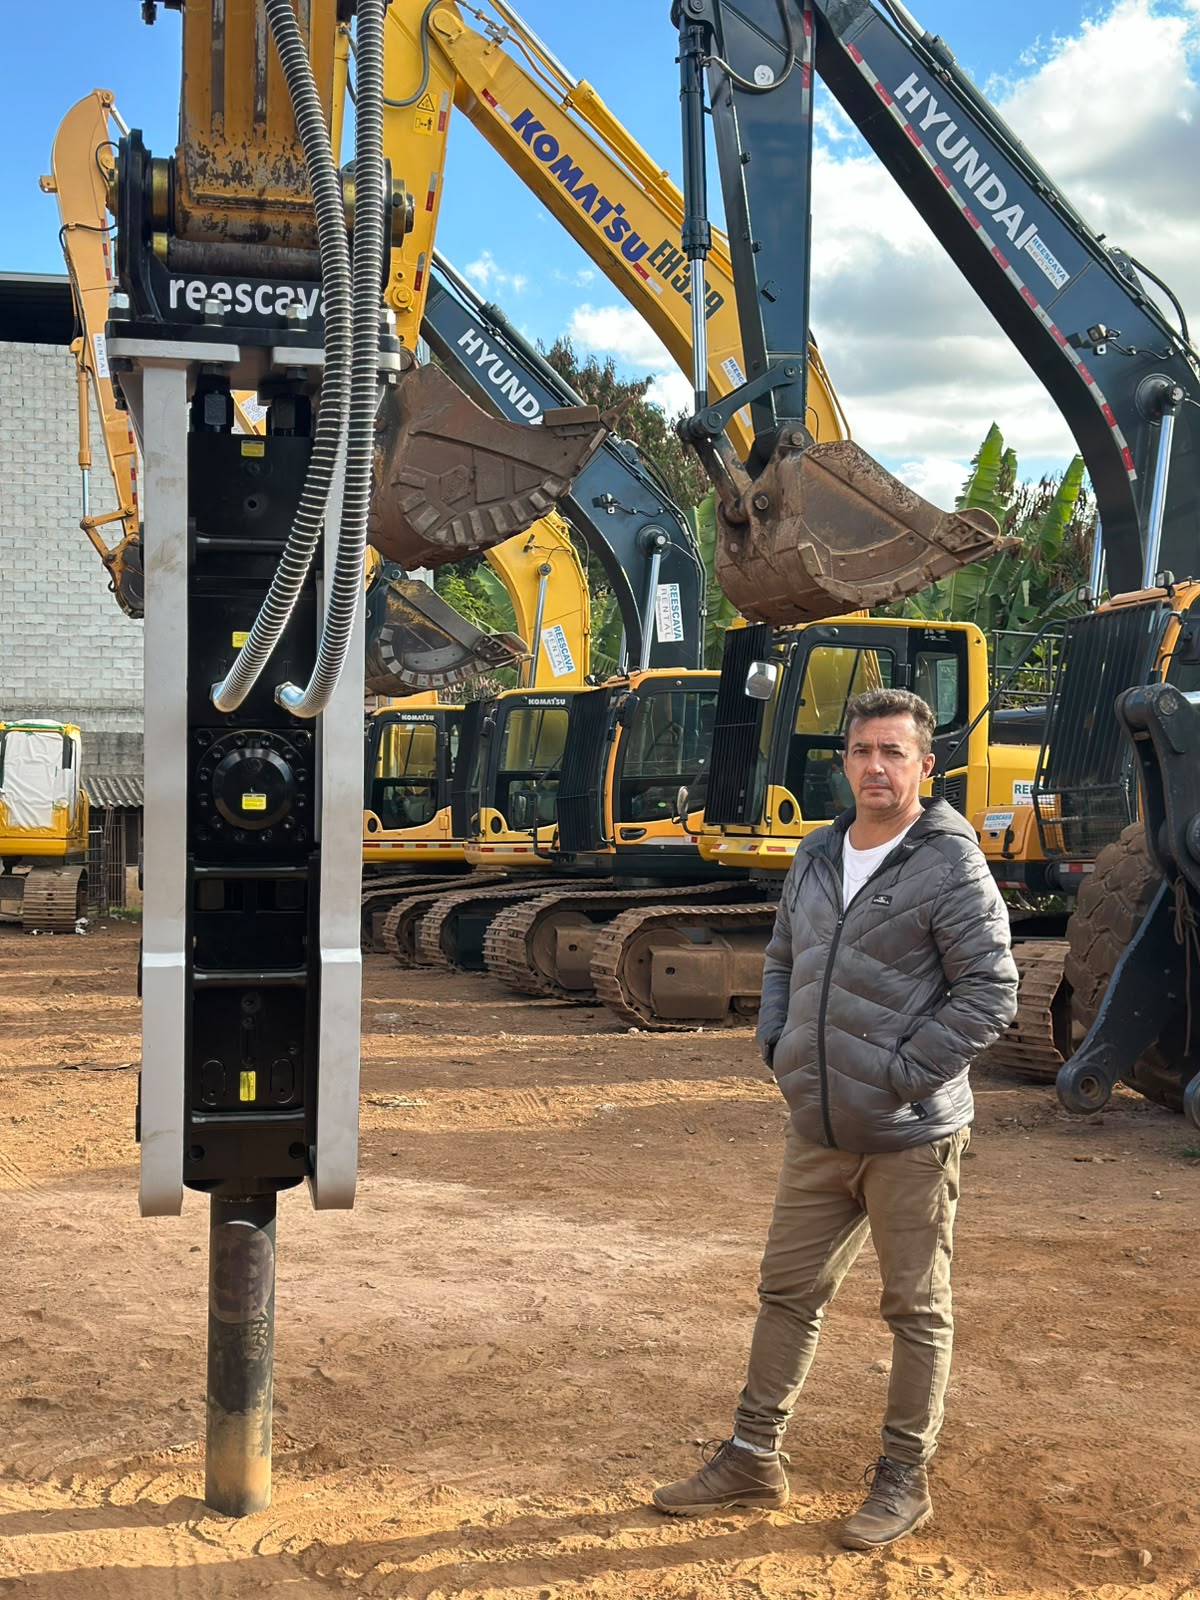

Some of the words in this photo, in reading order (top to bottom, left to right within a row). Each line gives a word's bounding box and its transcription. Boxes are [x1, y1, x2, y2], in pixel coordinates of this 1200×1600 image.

[511, 108, 650, 263] KOMATSU
[894, 72, 1038, 250] HYUNDAI
[647, 239, 725, 321] EH39
[1031, 238, 1066, 281] REESCAVA
[660, 588, 671, 639] RENTAL
[669, 584, 682, 640] REESCAVA
[547, 631, 564, 672] RENTAL
[554, 625, 574, 672] REESCAVA
[401, 713, 435, 721] KOMATSU
[528, 697, 566, 705] KOMATSU
